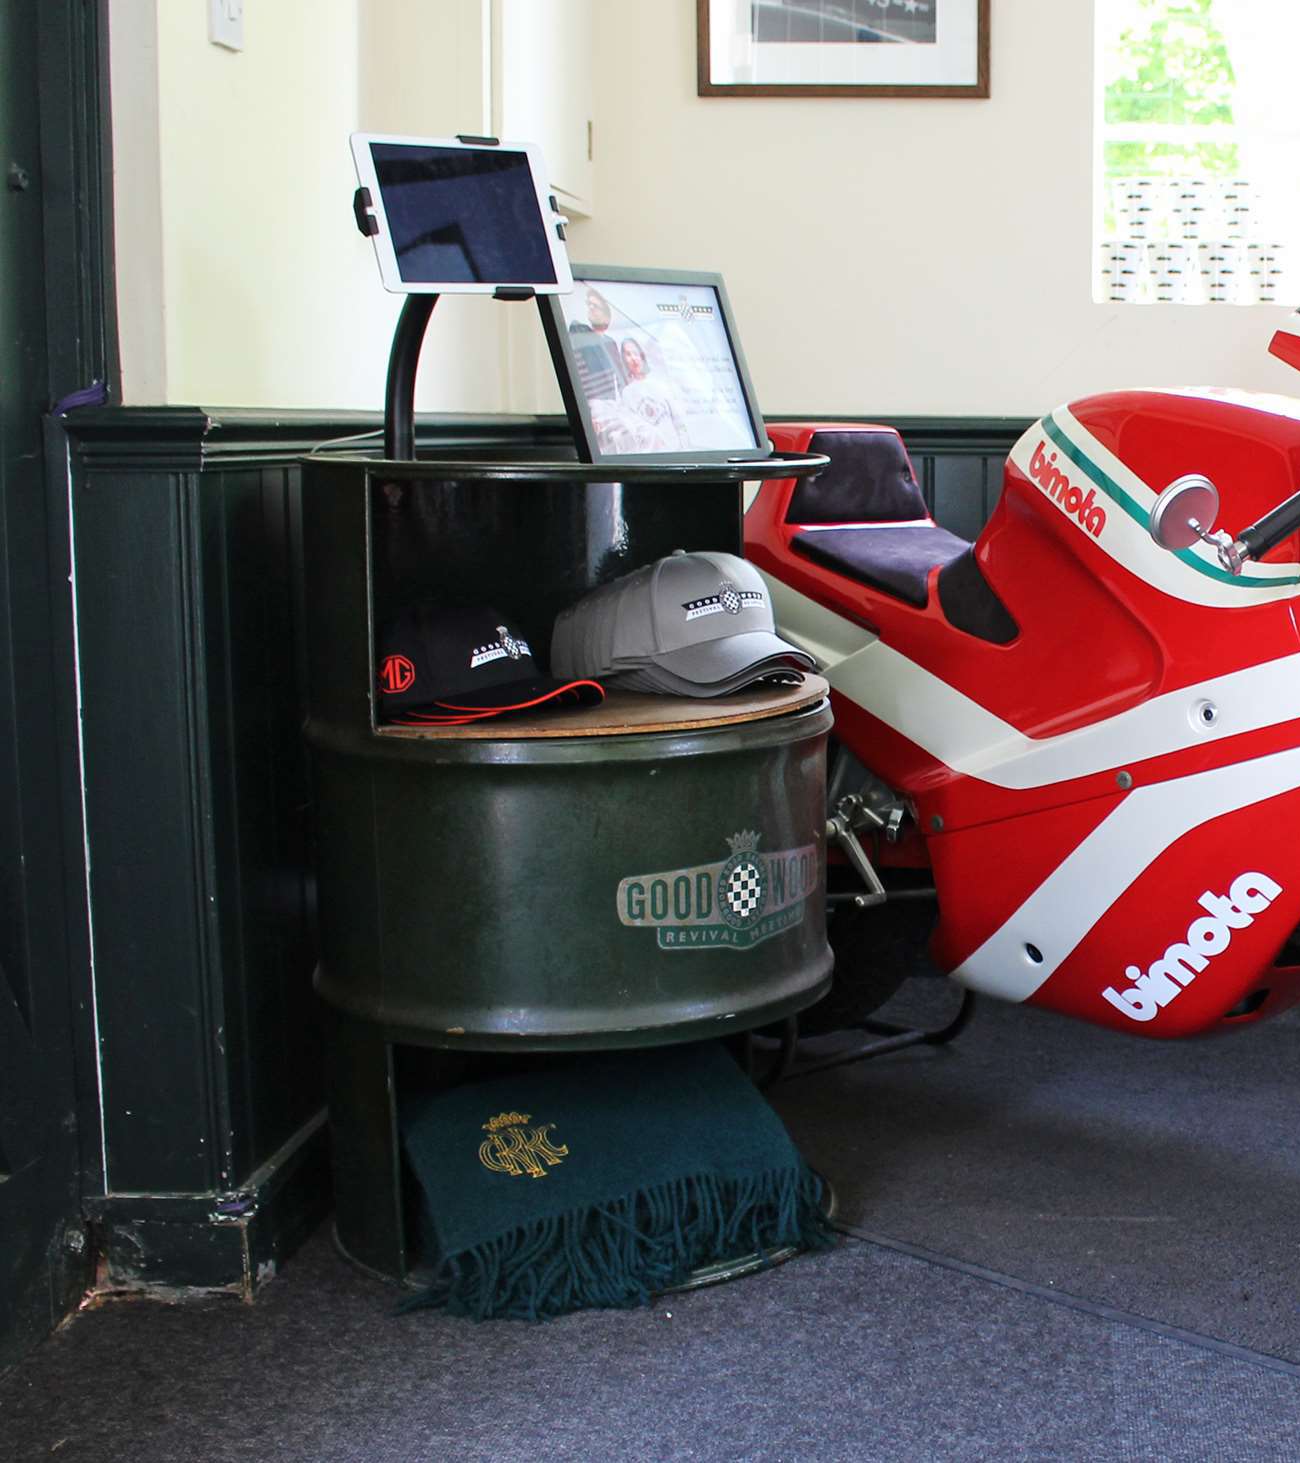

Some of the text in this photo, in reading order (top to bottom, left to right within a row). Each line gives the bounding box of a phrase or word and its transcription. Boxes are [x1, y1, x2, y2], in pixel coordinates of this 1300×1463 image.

[1029, 440, 1106, 537] bimota
[626, 872, 713, 921] GOOD
[666, 930, 739, 944] REVIVAL
[1102, 872, 1283, 1022] bimota
